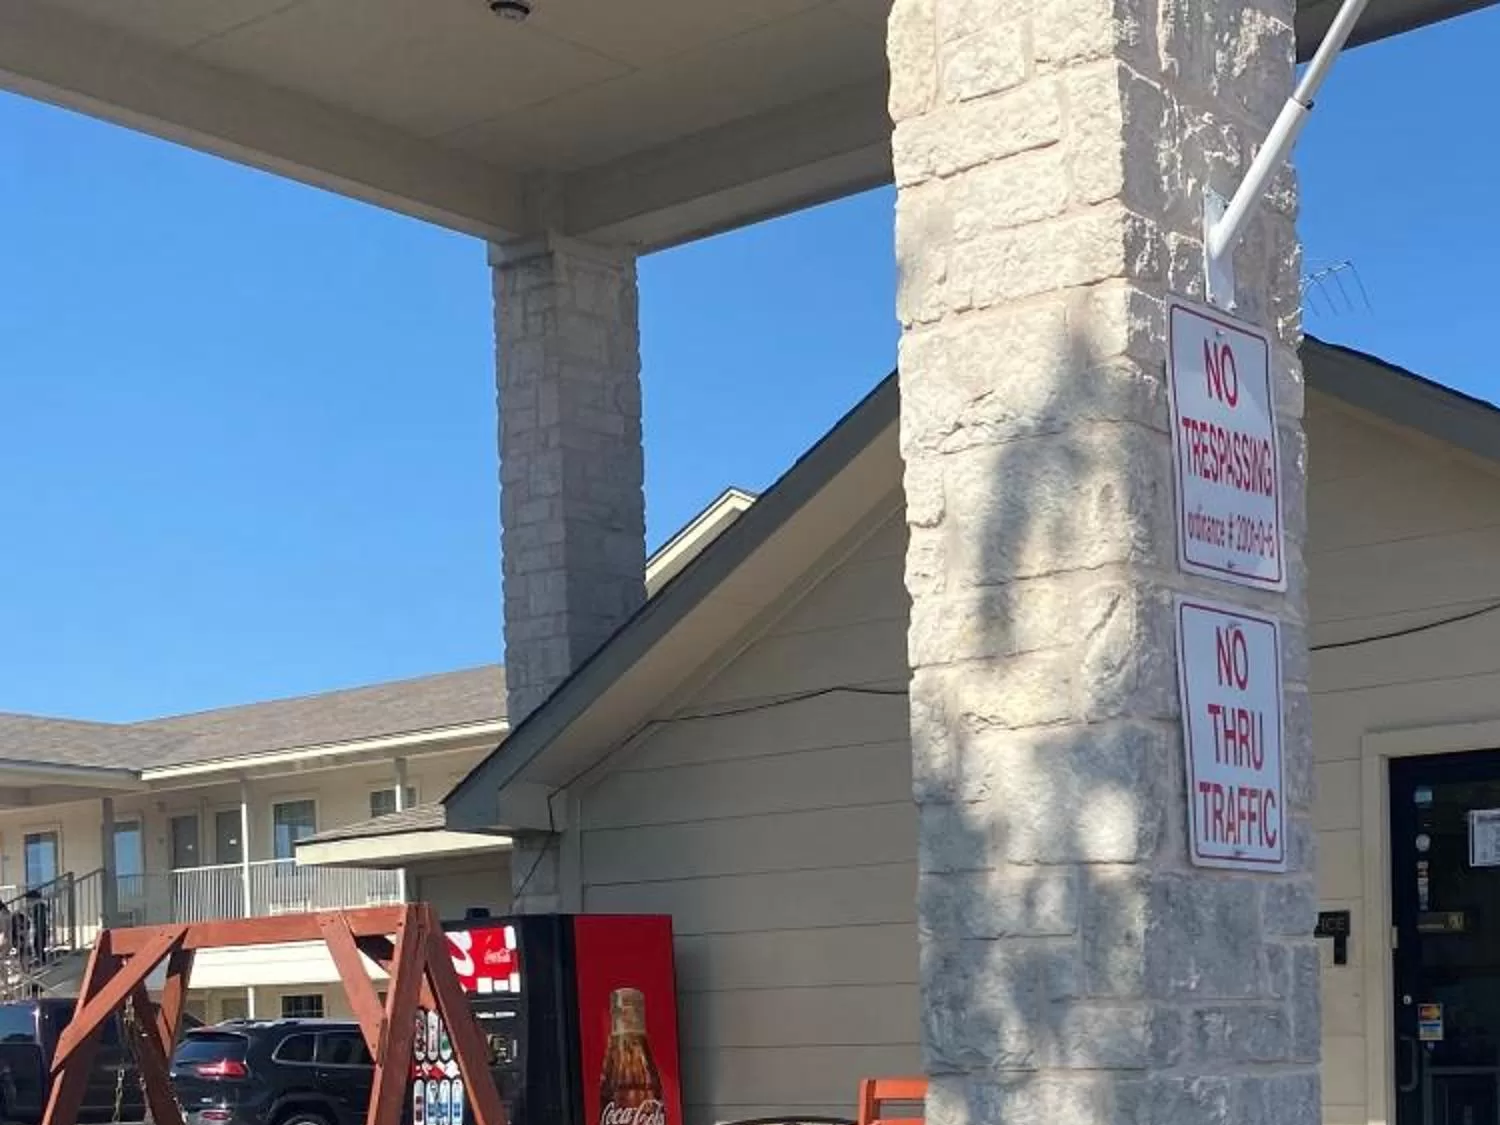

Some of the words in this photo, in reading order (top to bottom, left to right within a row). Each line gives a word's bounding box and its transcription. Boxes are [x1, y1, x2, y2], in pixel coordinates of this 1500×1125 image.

[1203, 336, 1239, 408] NO
[1182, 415, 1273, 497] TRESPASSING
[1215, 625, 1249, 691] NO
[1207, 703, 1265, 771] THRU
[1199, 781, 1277, 849] TRAFFIC
